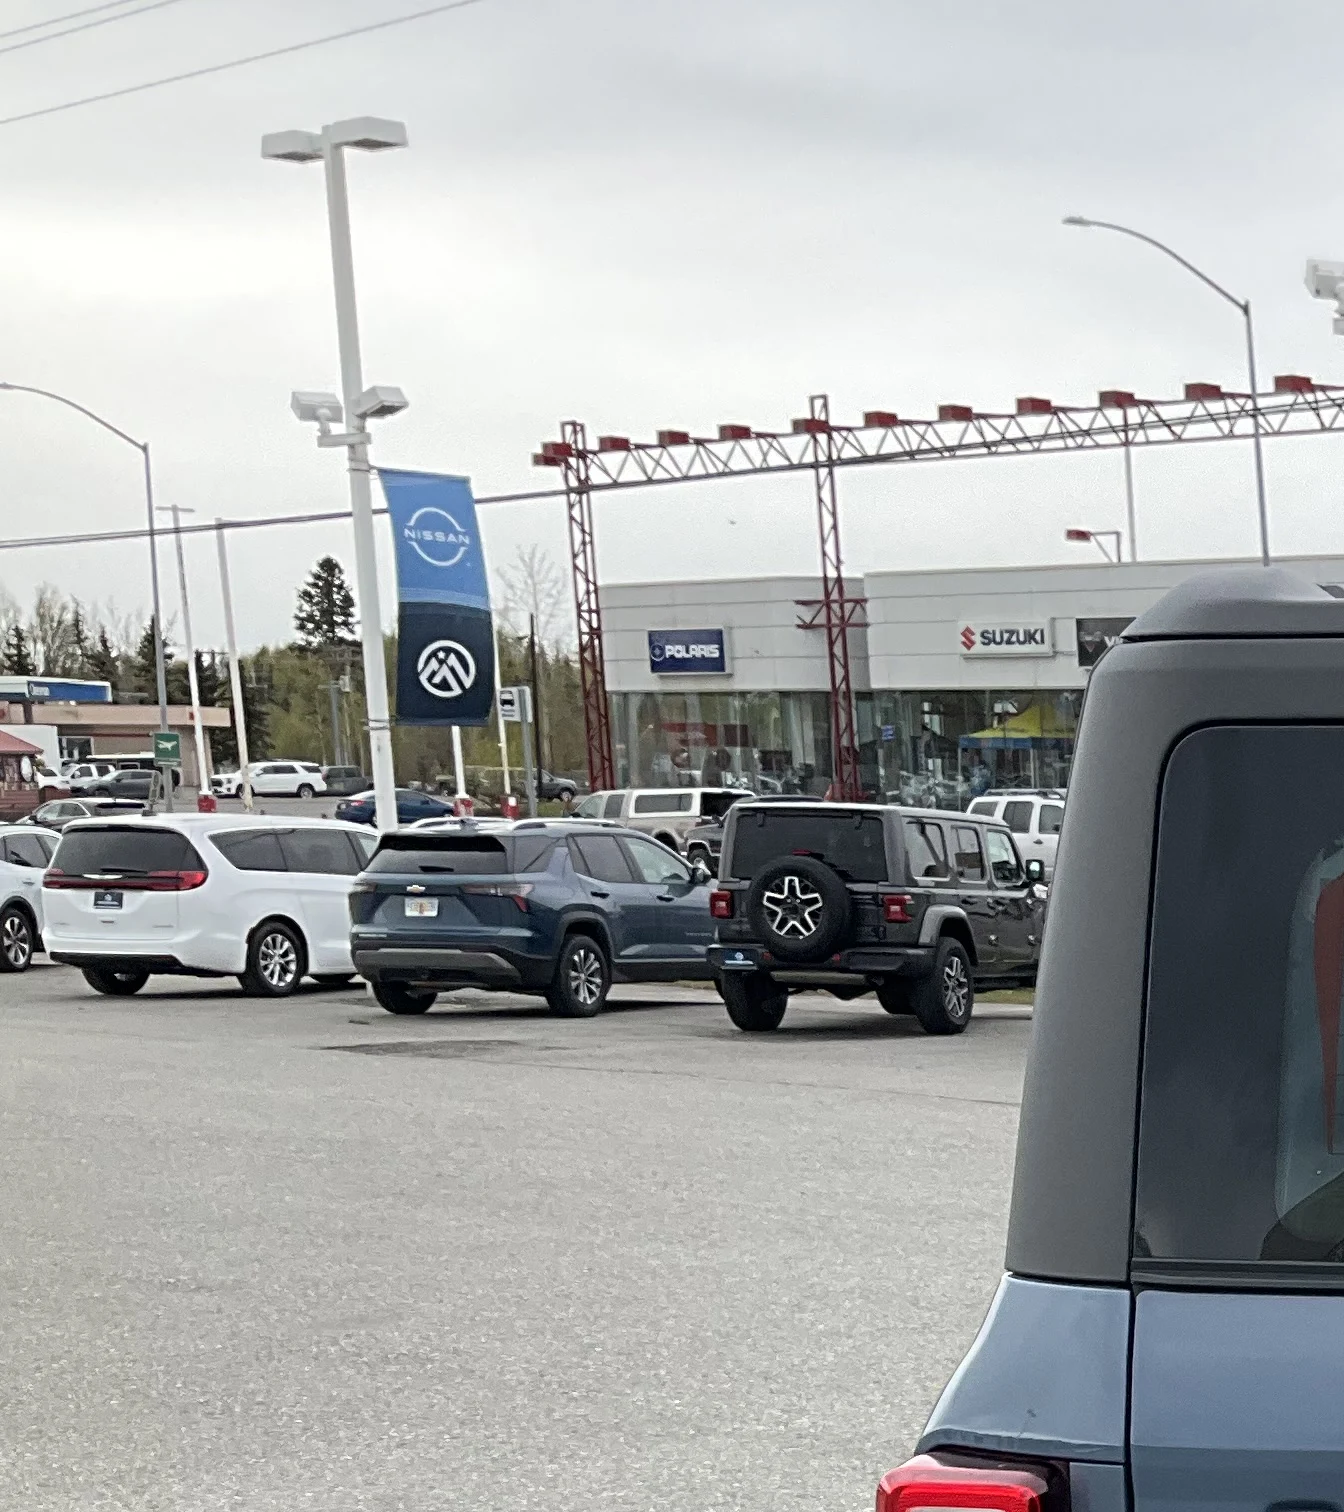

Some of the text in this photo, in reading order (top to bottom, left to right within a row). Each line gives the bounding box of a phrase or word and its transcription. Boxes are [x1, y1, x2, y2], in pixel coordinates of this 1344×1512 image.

[403, 527, 470, 545] NISSAN
[979, 628, 1046, 647] SUZUKI
[664, 643, 720, 659] POLARIS
